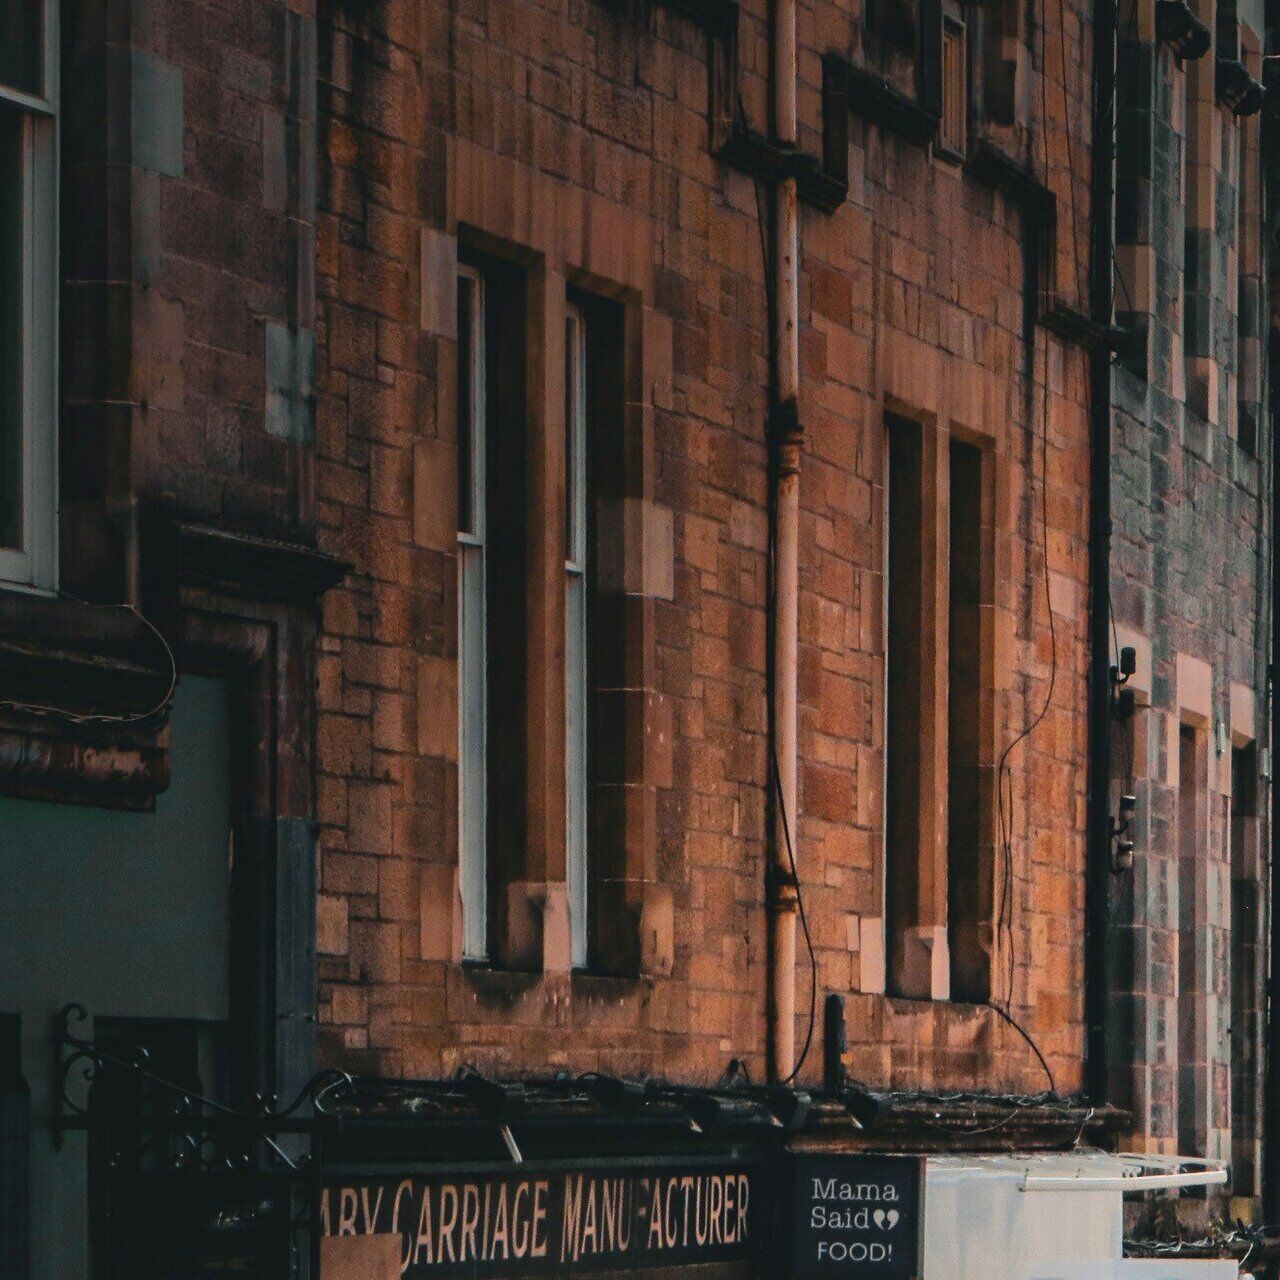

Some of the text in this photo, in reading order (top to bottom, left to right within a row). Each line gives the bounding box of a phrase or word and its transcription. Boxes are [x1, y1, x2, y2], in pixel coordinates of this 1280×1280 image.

[811, 1178, 899, 1201] Mama
[391, 1179, 548, 1273] CARRIAGE
[811, 1206, 870, 1229] Said
[817, 1241, 893, 1262] FOOD!
